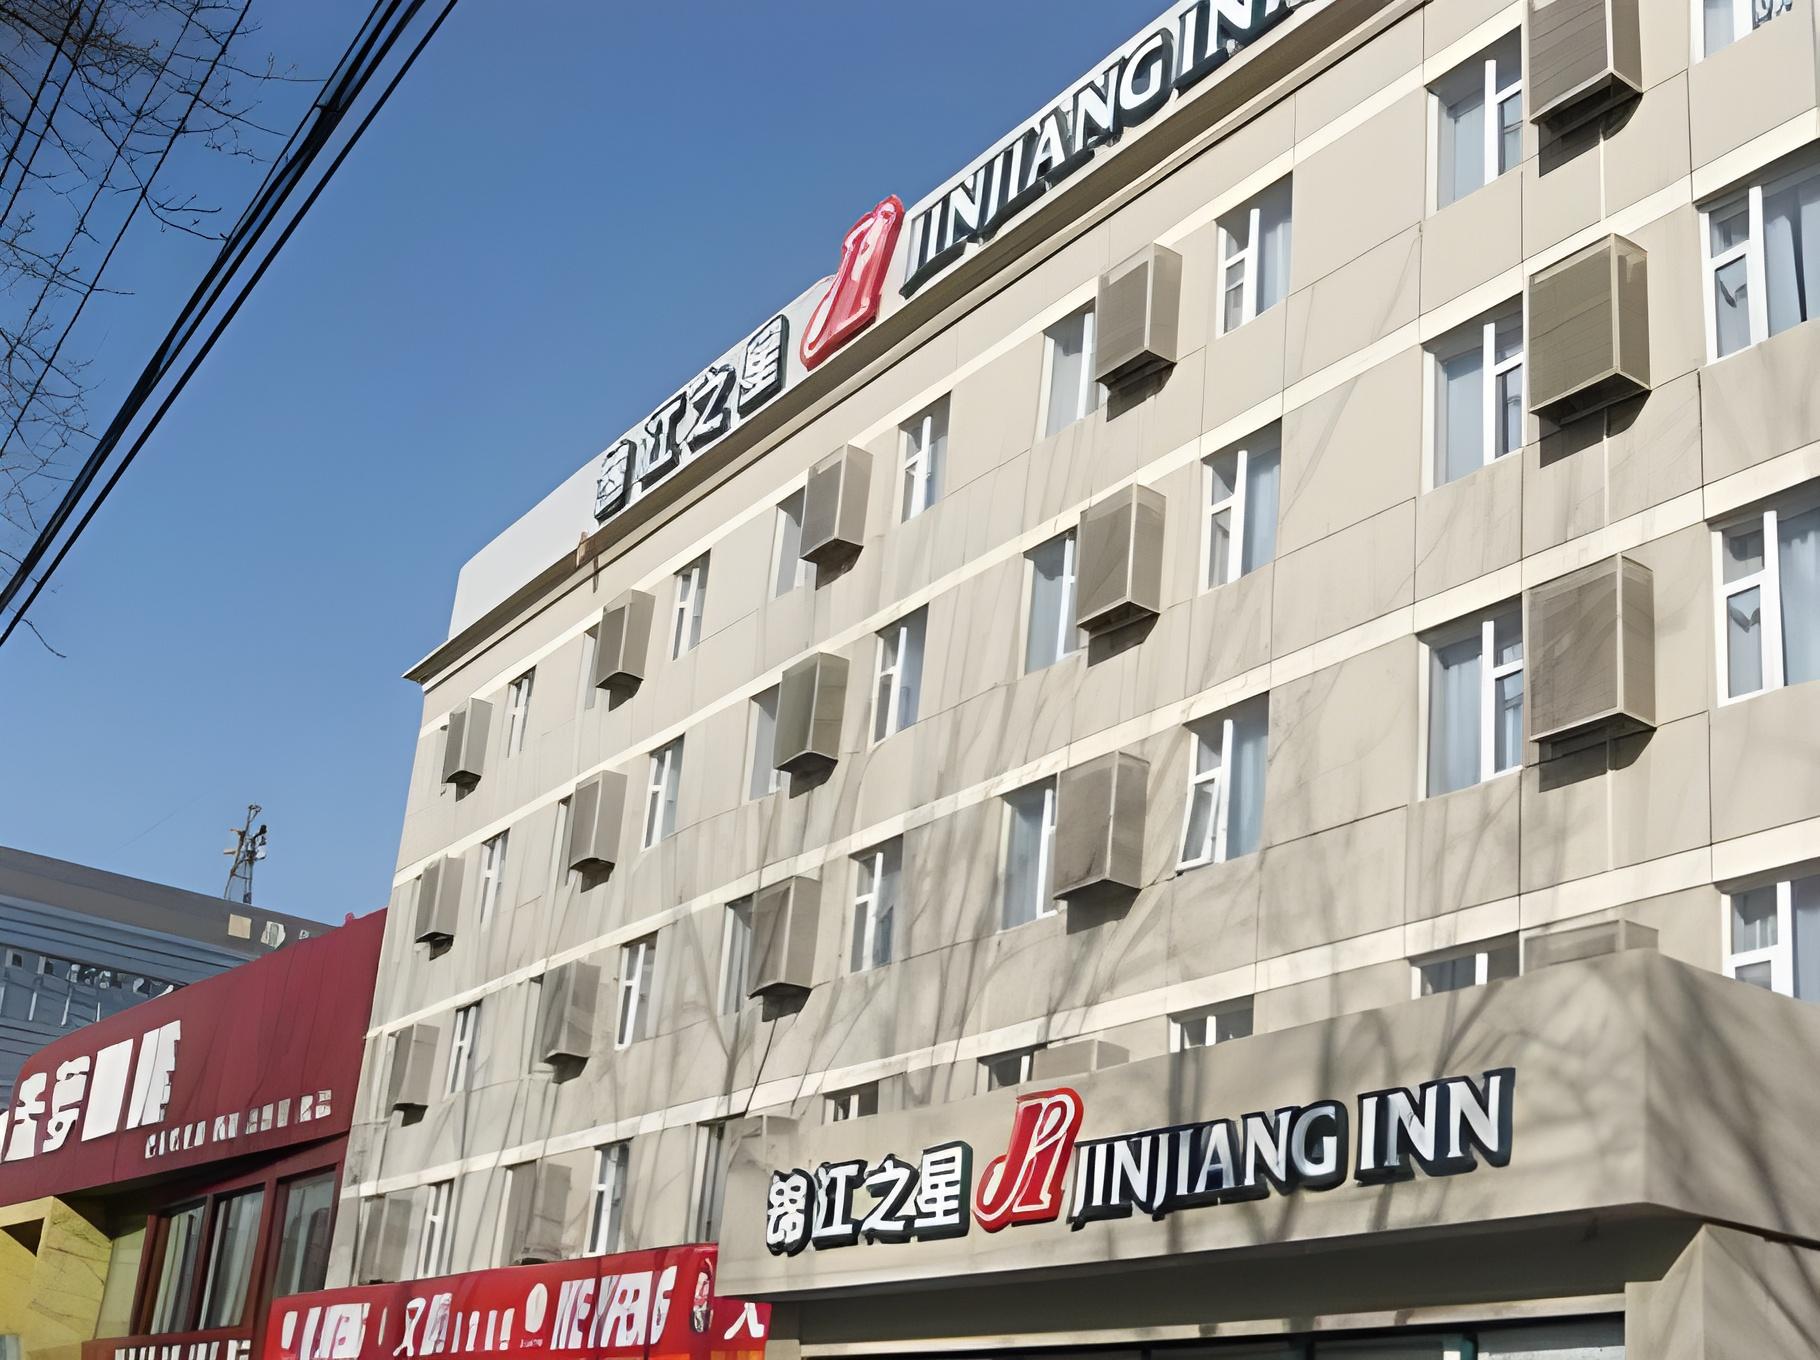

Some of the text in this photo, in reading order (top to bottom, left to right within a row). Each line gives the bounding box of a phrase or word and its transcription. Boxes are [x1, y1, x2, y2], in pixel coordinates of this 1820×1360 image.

[902, 30, 1169, 293] JINJIANG
[1177, 0, 1300, 84] IN
[1071, 1070, 1512, 1226] JINJIANG INN
